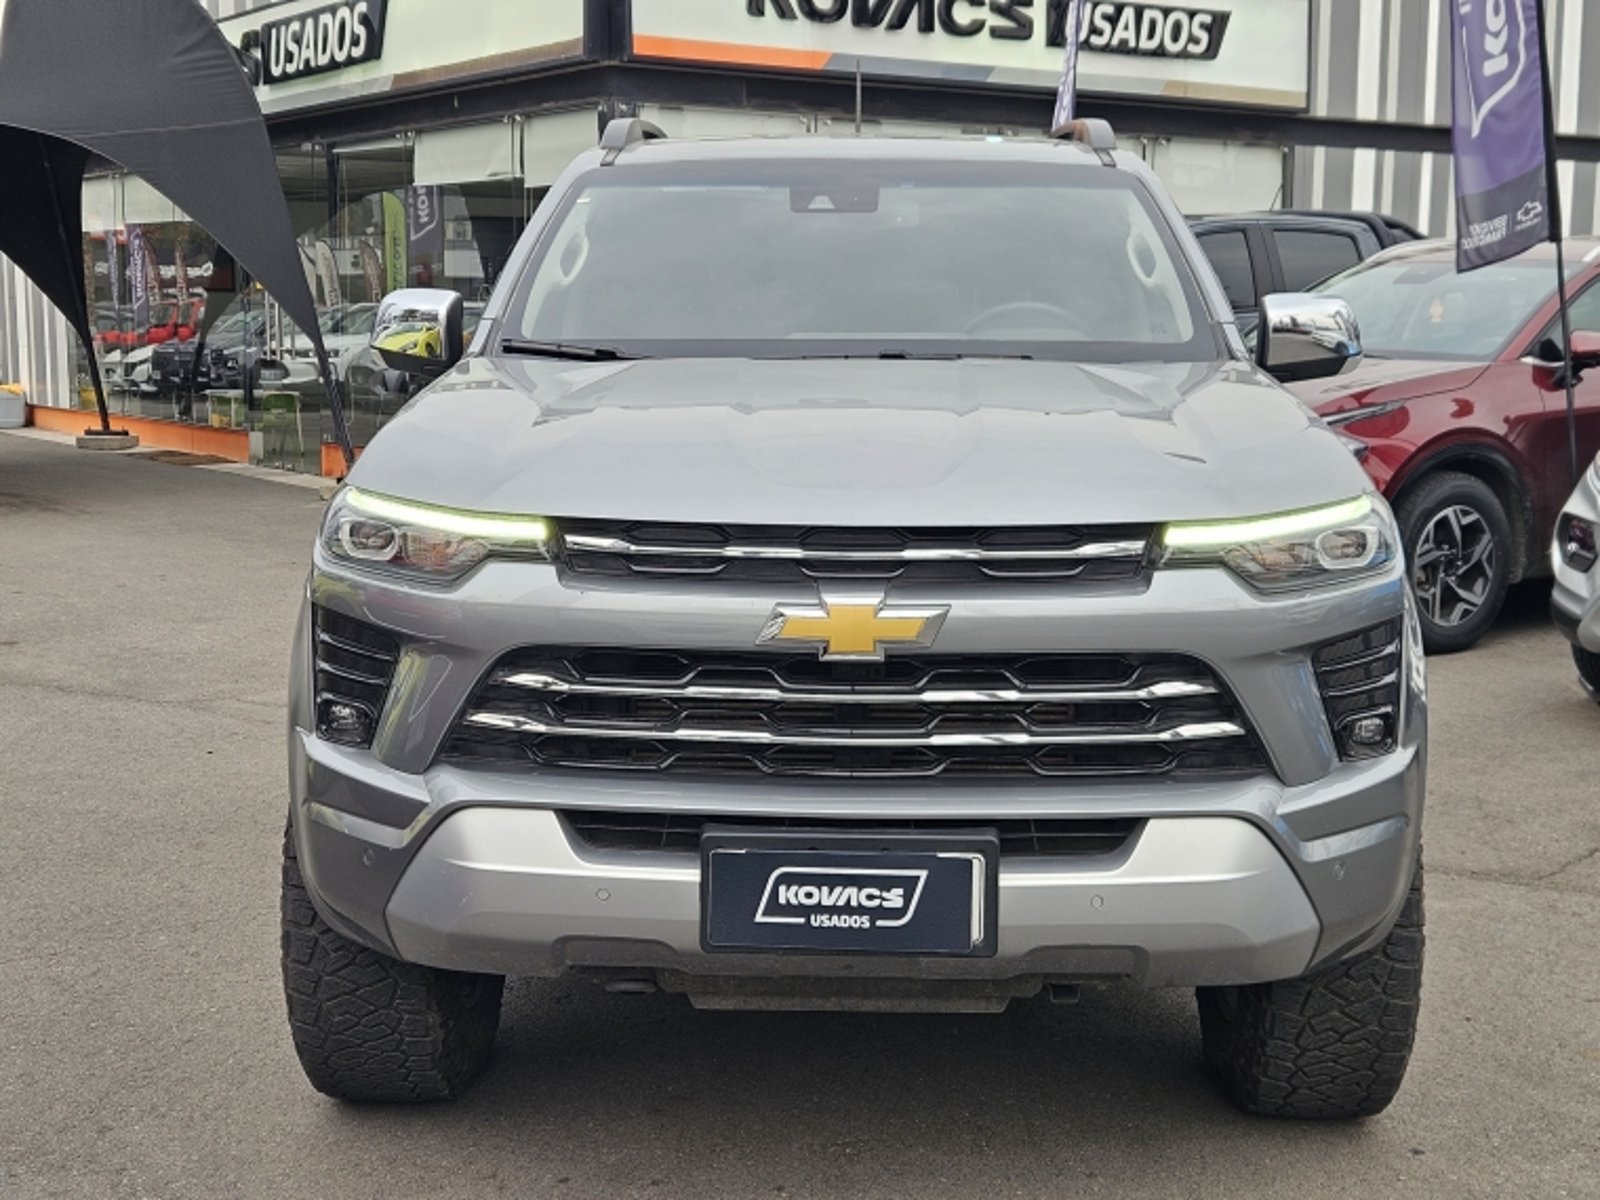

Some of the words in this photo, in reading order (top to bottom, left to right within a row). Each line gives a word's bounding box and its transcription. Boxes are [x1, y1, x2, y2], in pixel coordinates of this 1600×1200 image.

[269, 1, 368, 78] USADOS
[778, 884, 904, 908] KOVACS
[810, 913, 870, 928] USADOS
